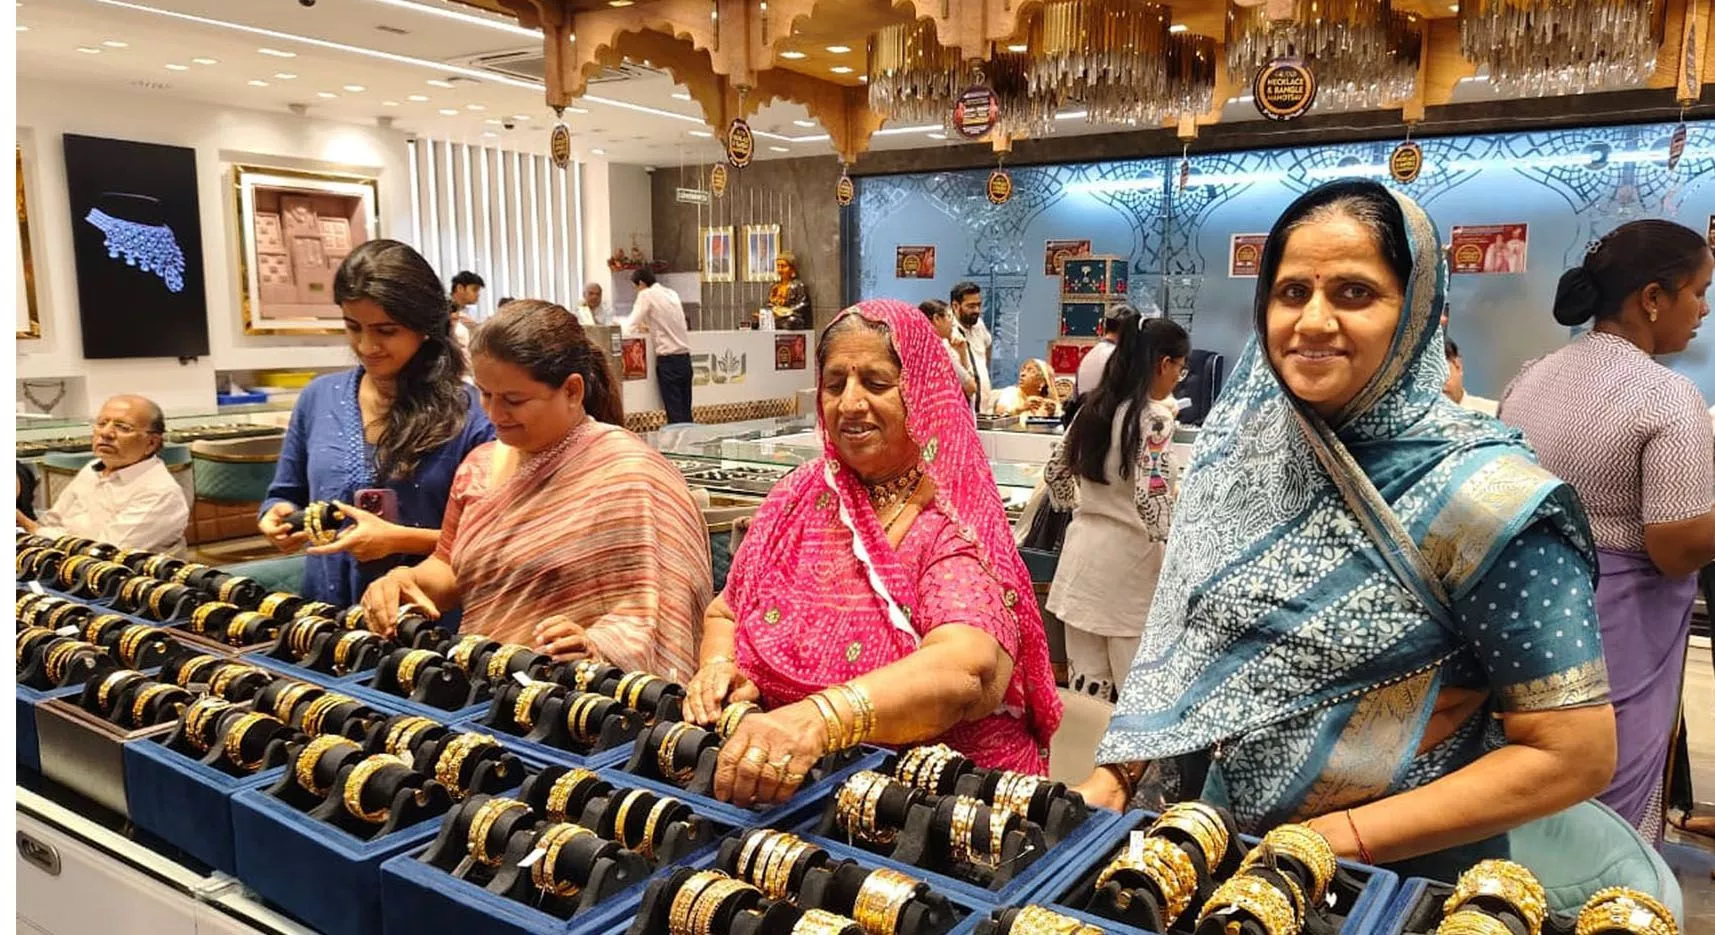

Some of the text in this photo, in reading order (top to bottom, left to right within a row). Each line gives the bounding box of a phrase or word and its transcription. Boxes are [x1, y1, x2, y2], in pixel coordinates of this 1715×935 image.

[1267, 78, 1304, 86] NECKLACE
[1267, 86, 1304, 94] & BANGLE
